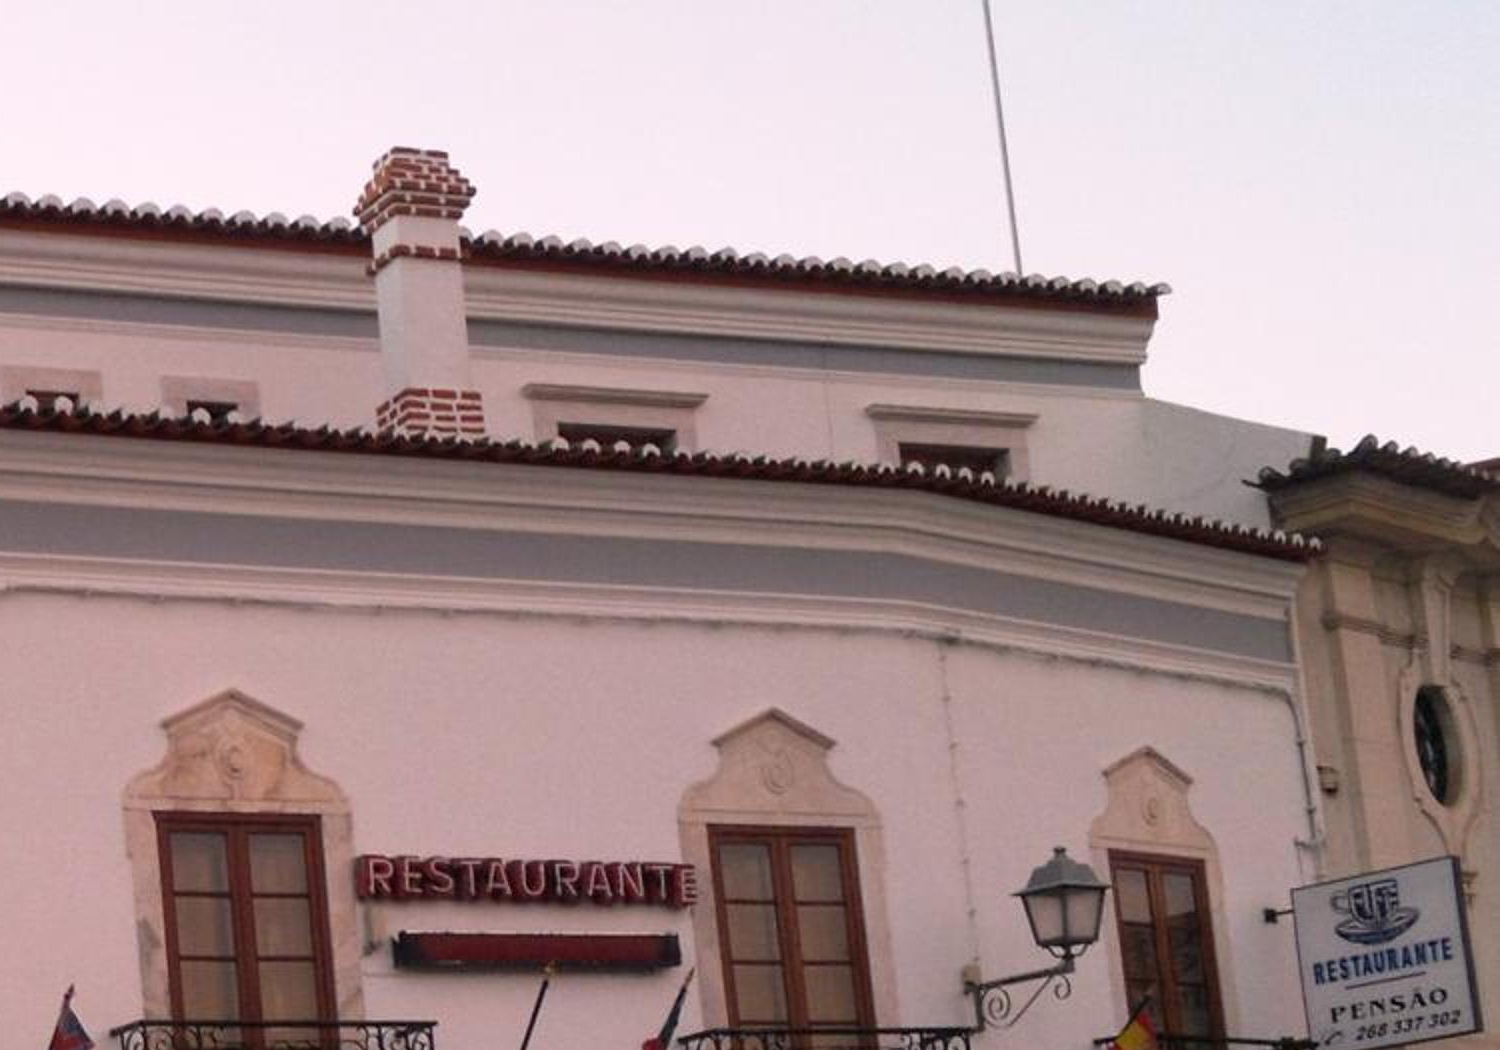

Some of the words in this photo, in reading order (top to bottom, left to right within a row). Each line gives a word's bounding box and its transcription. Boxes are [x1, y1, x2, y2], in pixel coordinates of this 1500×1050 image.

[360, 855, 699, 905] RESTAURANTE
[1314, 938, 1454, 985] RESTAURANTE
[1330, 986, 1448, 1024] PENSÃO
[1355, 1023, 1388, 1042] 268
[1392, 1017, 1424, 1035] 337
